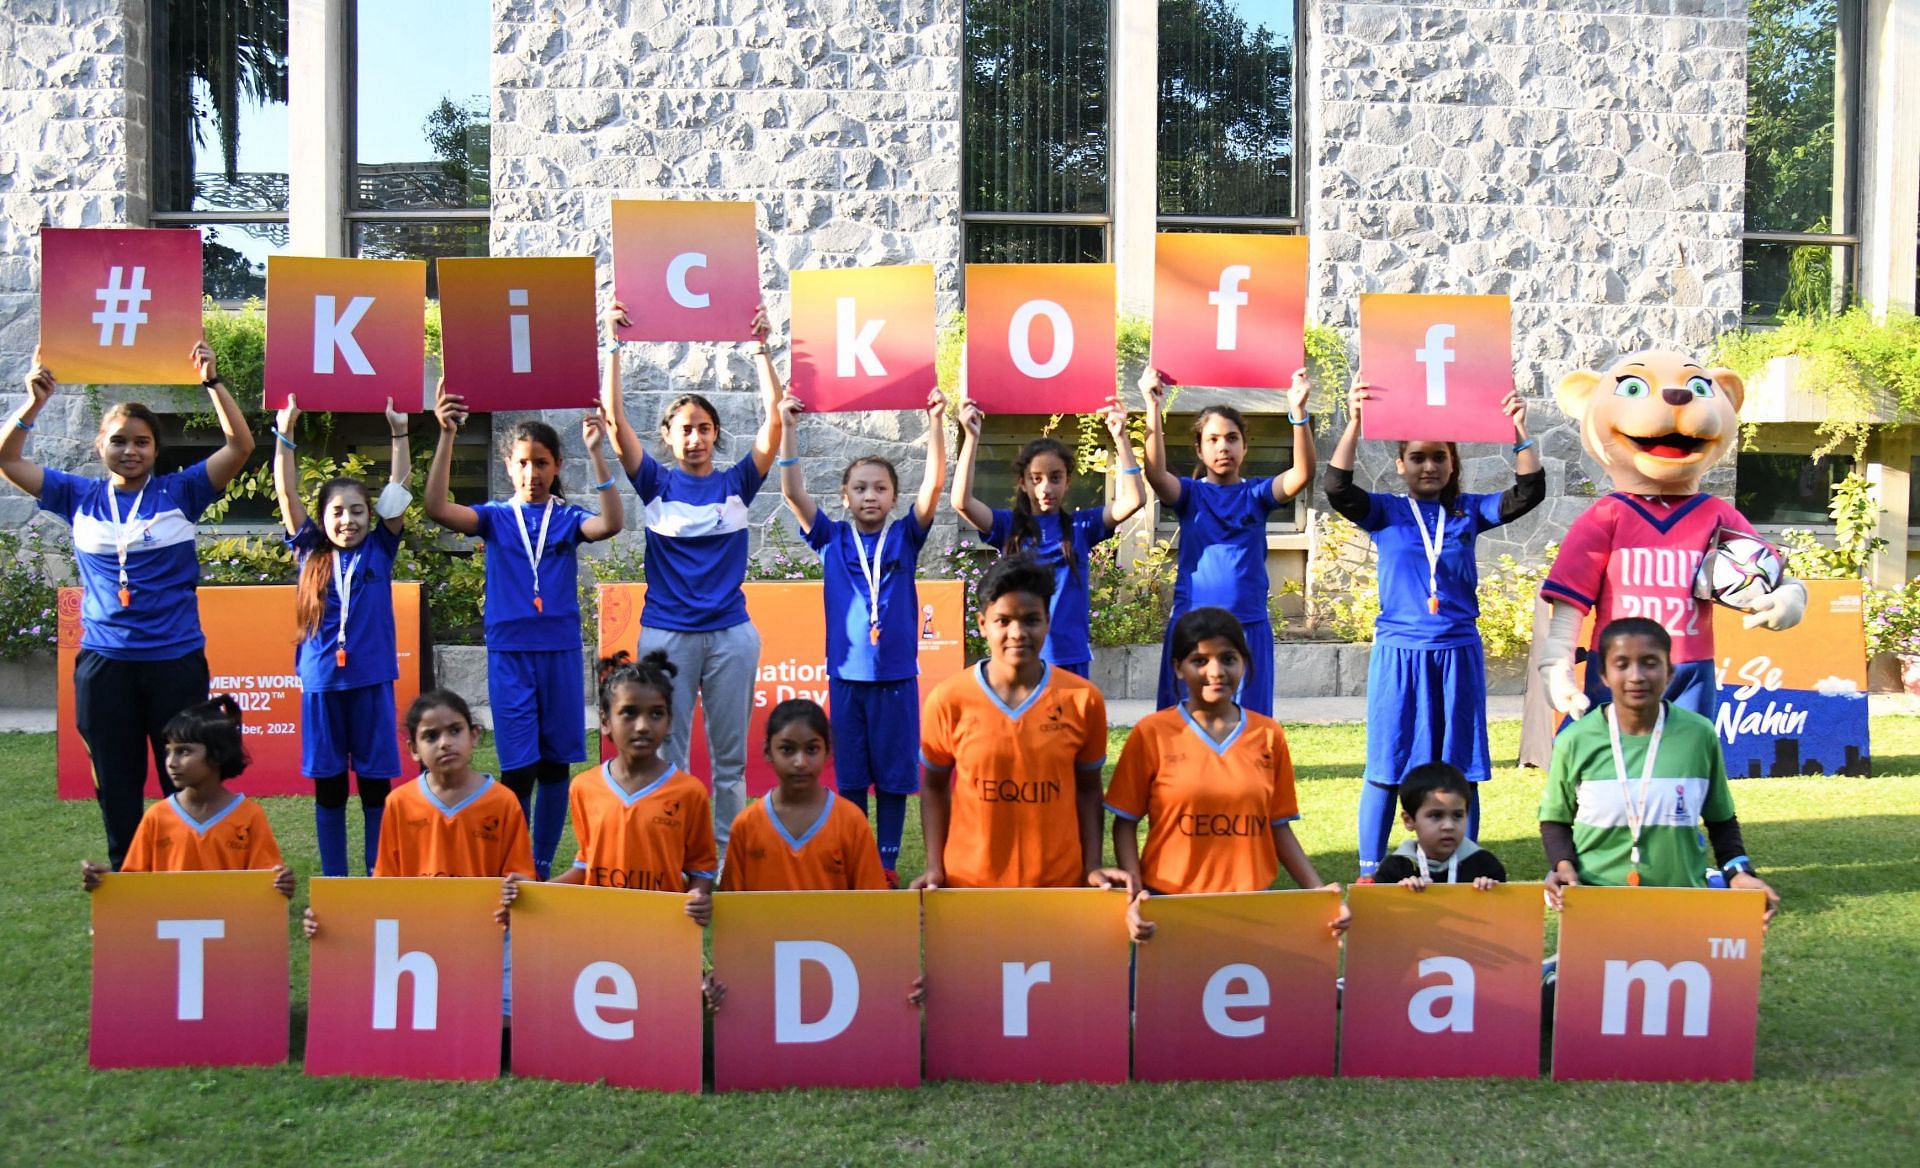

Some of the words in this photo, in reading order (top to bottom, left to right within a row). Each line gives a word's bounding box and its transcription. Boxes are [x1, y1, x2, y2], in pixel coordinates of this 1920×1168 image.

[92, 266, 152, 346] #
[666, 250, 711, 309] c
[1208, 264, 1252, 351] f
[313, 295, 376, 375] K
[509, 289, 531, 373] i
[836, 296, 888, 378] k
[1415, 323, 1456, 407] f
[1733, 656, 1783, 700] Se
[267, 723, 296, 734] 2022
[1714, 701, 1809, 744] Nahin
[1179, 813, 1267, 837] CEQUIN
[157, 919, 225, 1020] T
[372, 919, 438, 1030] h
[574, 961, 638, 1040] e
[775, 940, 860, 1043] D
[1002, 961, 1051, 1036] r
[1203, 963, 1270, 1037] e
[1408, 956, 1475, 1033] a
